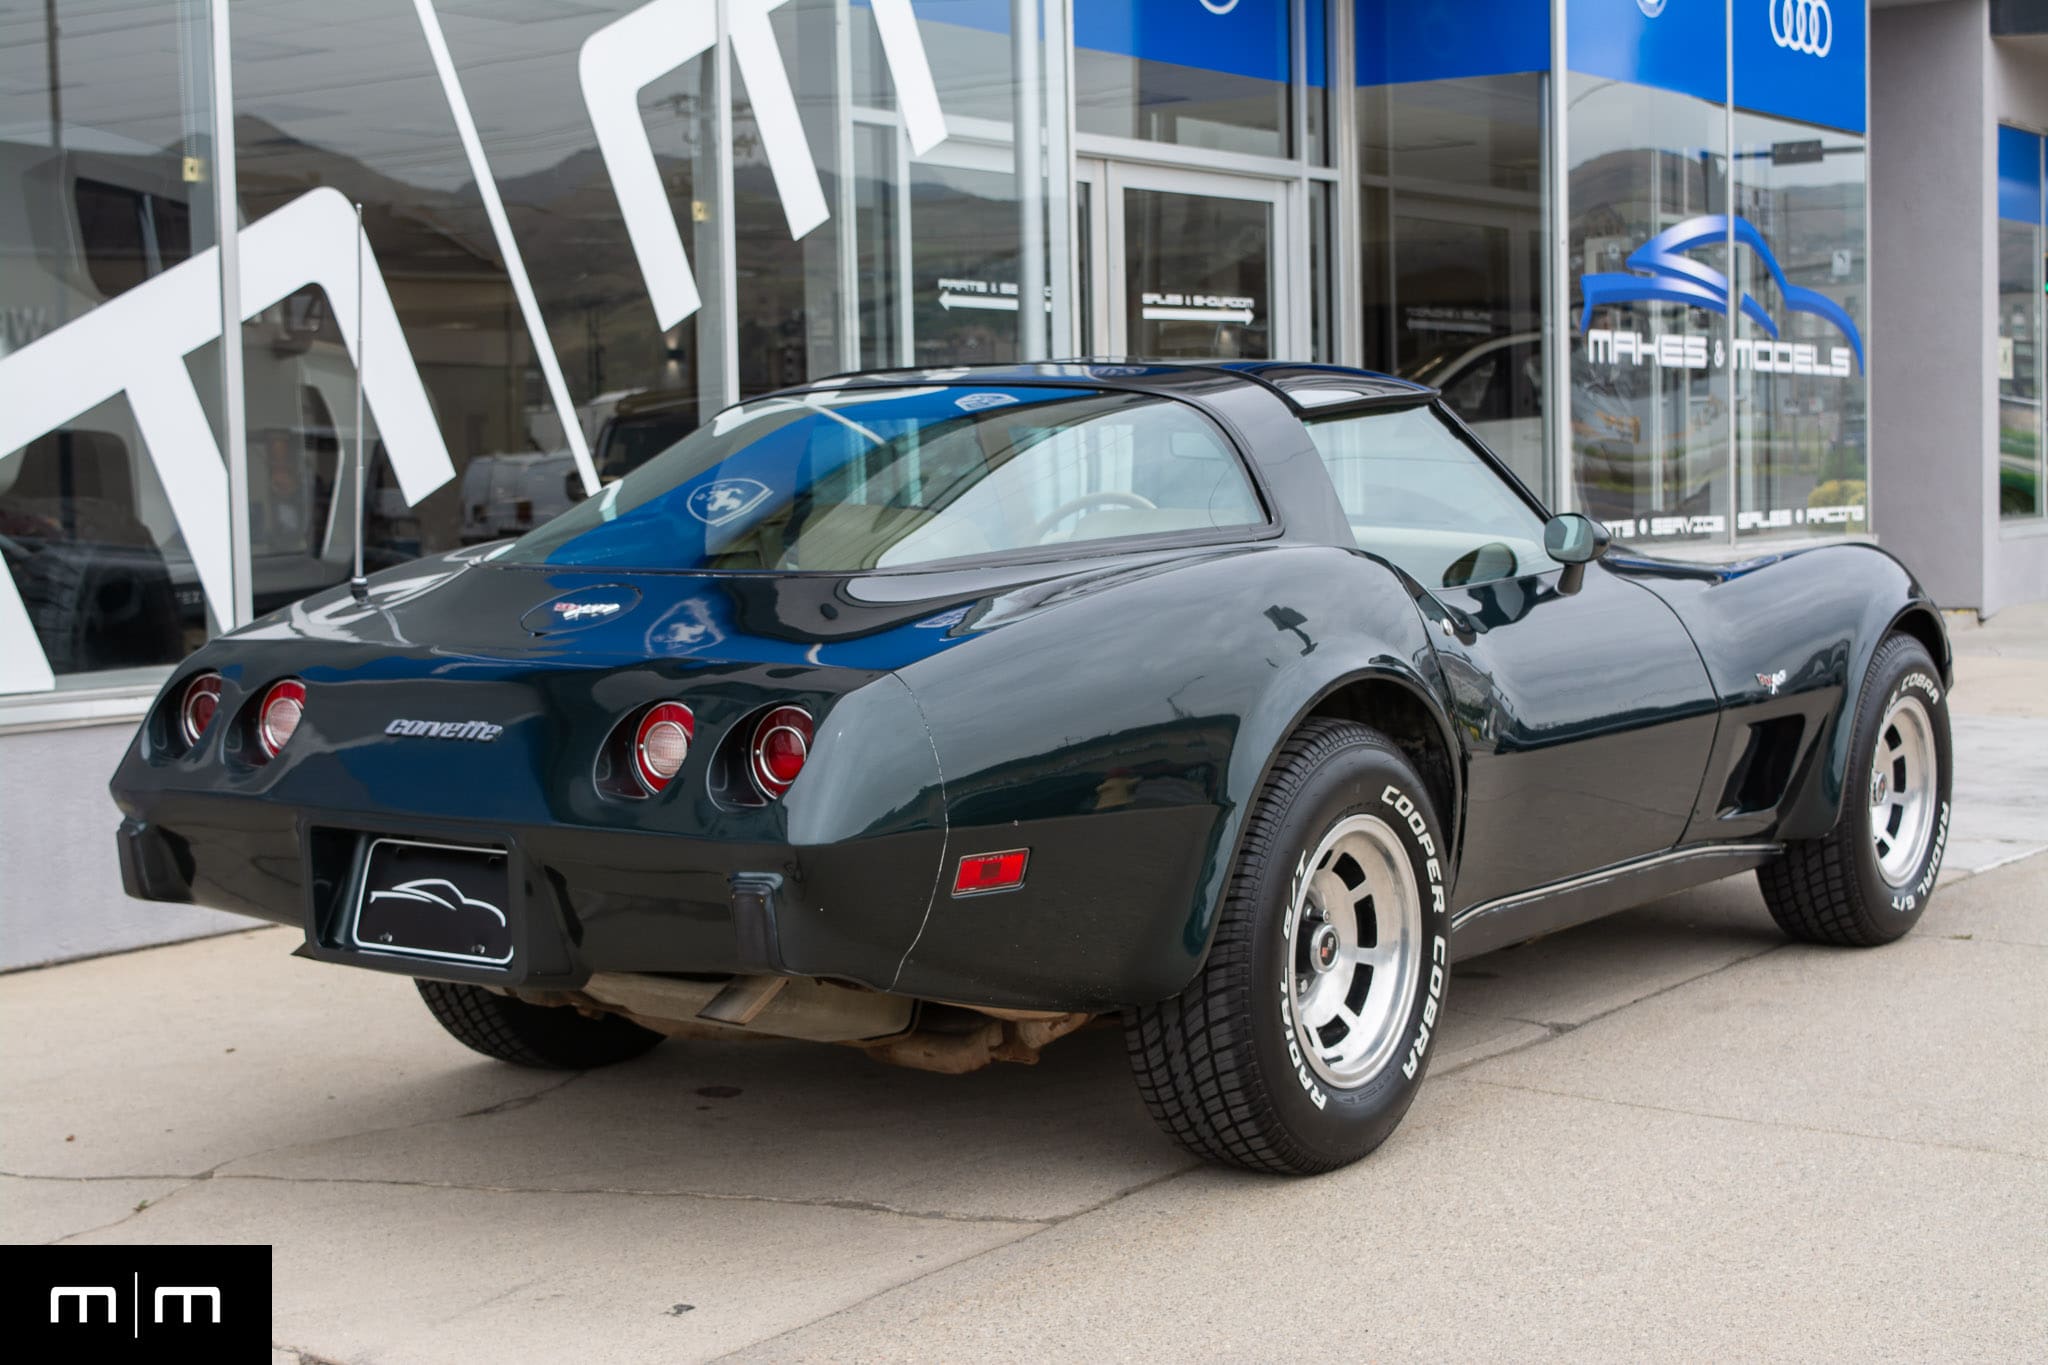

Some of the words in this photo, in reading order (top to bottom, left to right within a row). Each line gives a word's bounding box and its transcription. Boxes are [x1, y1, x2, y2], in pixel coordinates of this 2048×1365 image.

[1142, 292, 1184, 306] SALES
[1588, 329, 1708, 369] MAKES
[1713, 339, 1726, 368] &
[1732, 338, 1850, 378] MODELS
[1651, 516, 1726, 536] SERVICE
[1738, 508, 1792, 530] SALES
[1806, 504, 1865, 525] RACING
[1381, 784, 1446, 914] COOPER
[1280, 967, 1327, 1110] RADIAL
[1402, 935, 1446, 1081] COBRA
